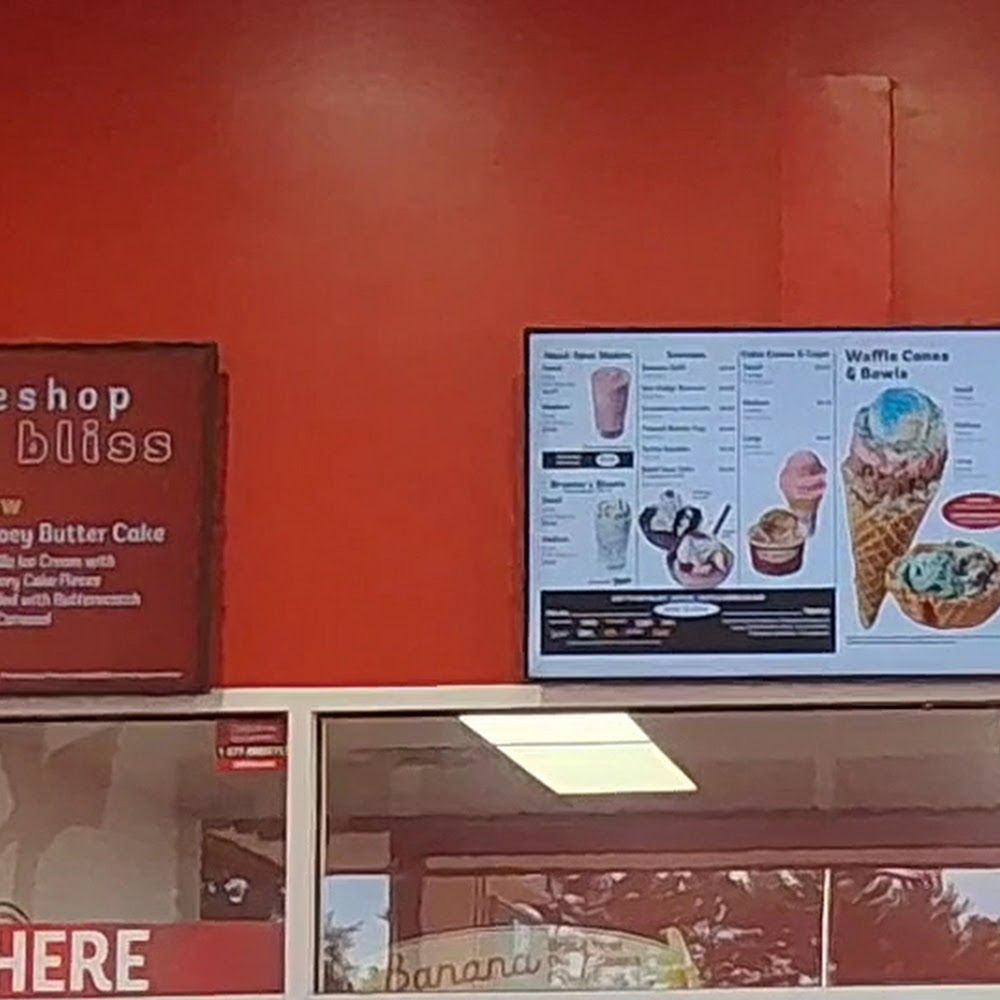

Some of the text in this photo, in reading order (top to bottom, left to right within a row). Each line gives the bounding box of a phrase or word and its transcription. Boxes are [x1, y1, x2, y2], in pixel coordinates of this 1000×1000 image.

[845, 349, 949, 363] Waffle Cones
[861, 366, 908, 379] Bowls
[18, 419, 172, 464] bliss
[38, 522, 108, 543] Butter
[112, 522, 165, 542] Cake
[0, 929, 150, 992] HERE
[388, 952, 542, 992] Banana
